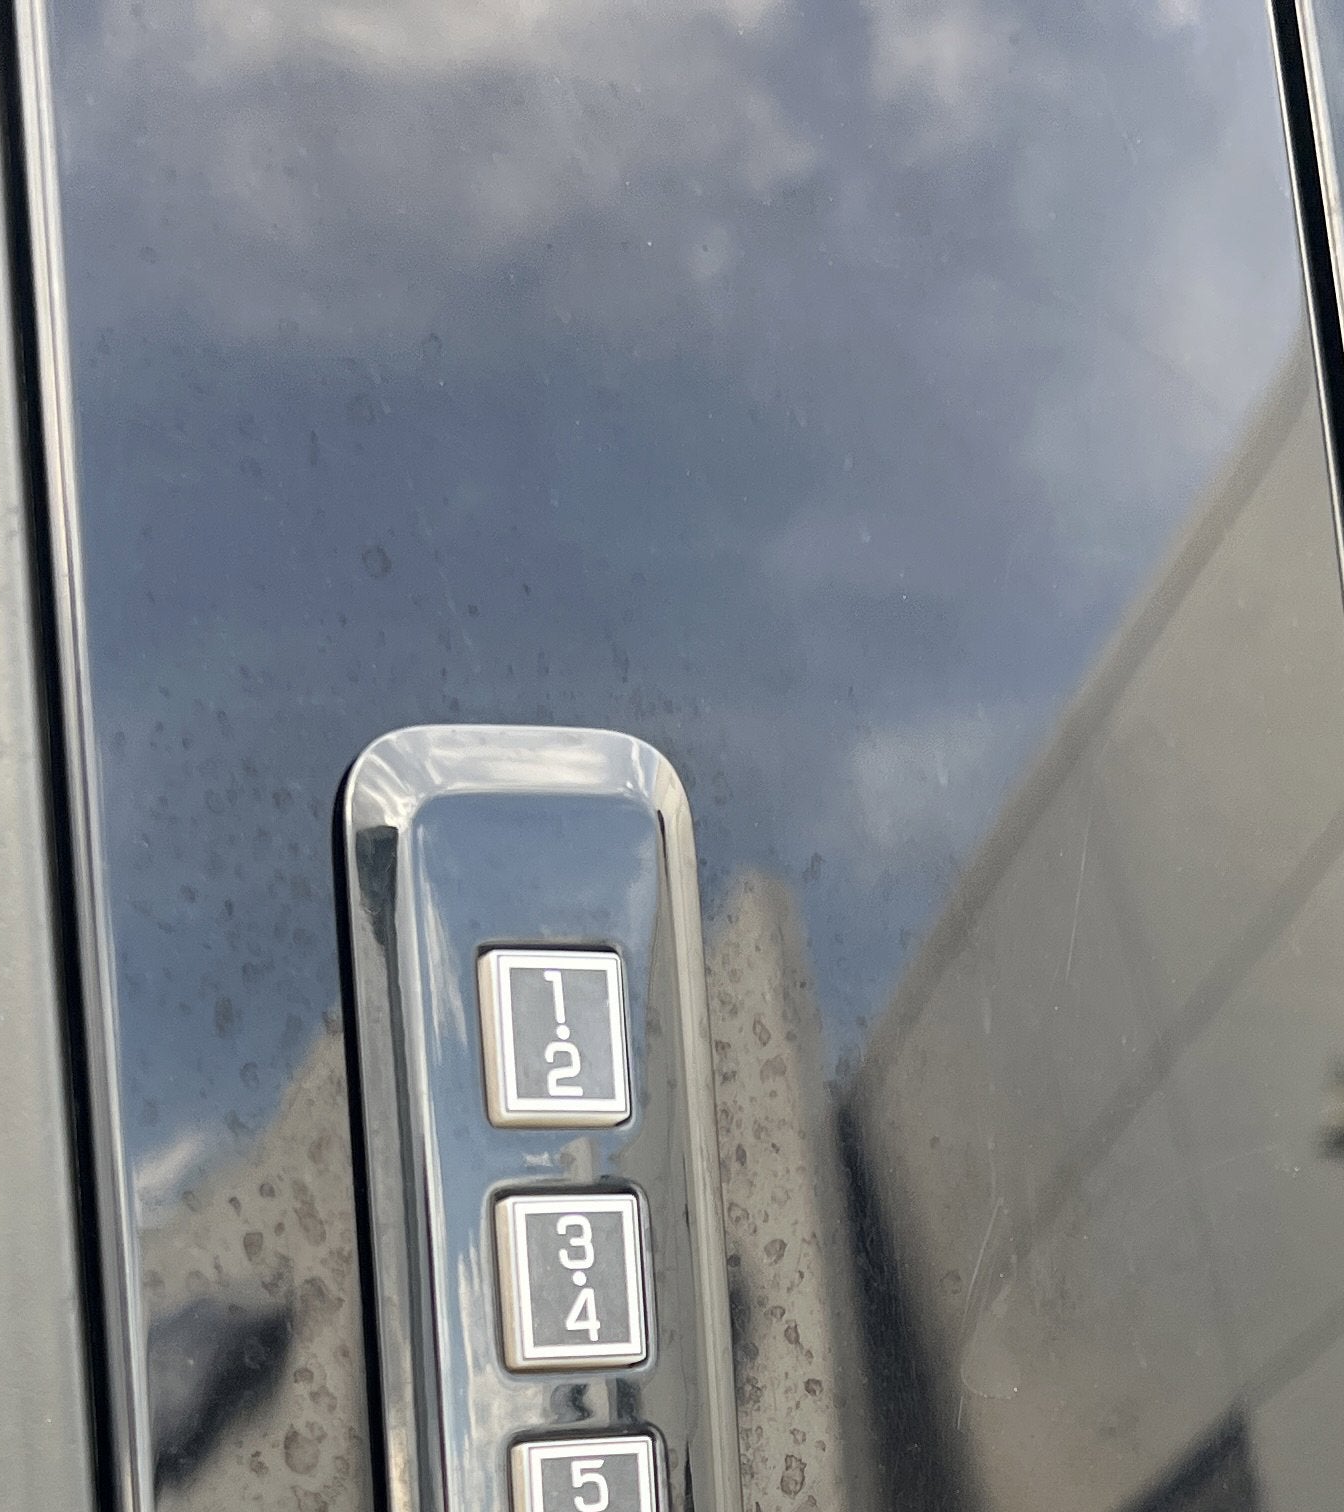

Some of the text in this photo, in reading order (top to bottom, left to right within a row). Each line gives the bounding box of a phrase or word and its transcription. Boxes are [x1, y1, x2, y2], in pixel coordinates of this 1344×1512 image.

[543, 970, 567, 1025] 1
[544, 1041, 584, 1097] 2
[556, 1214, 595, 1270] 3
[565, 1287, 601, 1342] 4
[570, 1459, 609, 1512] 5
